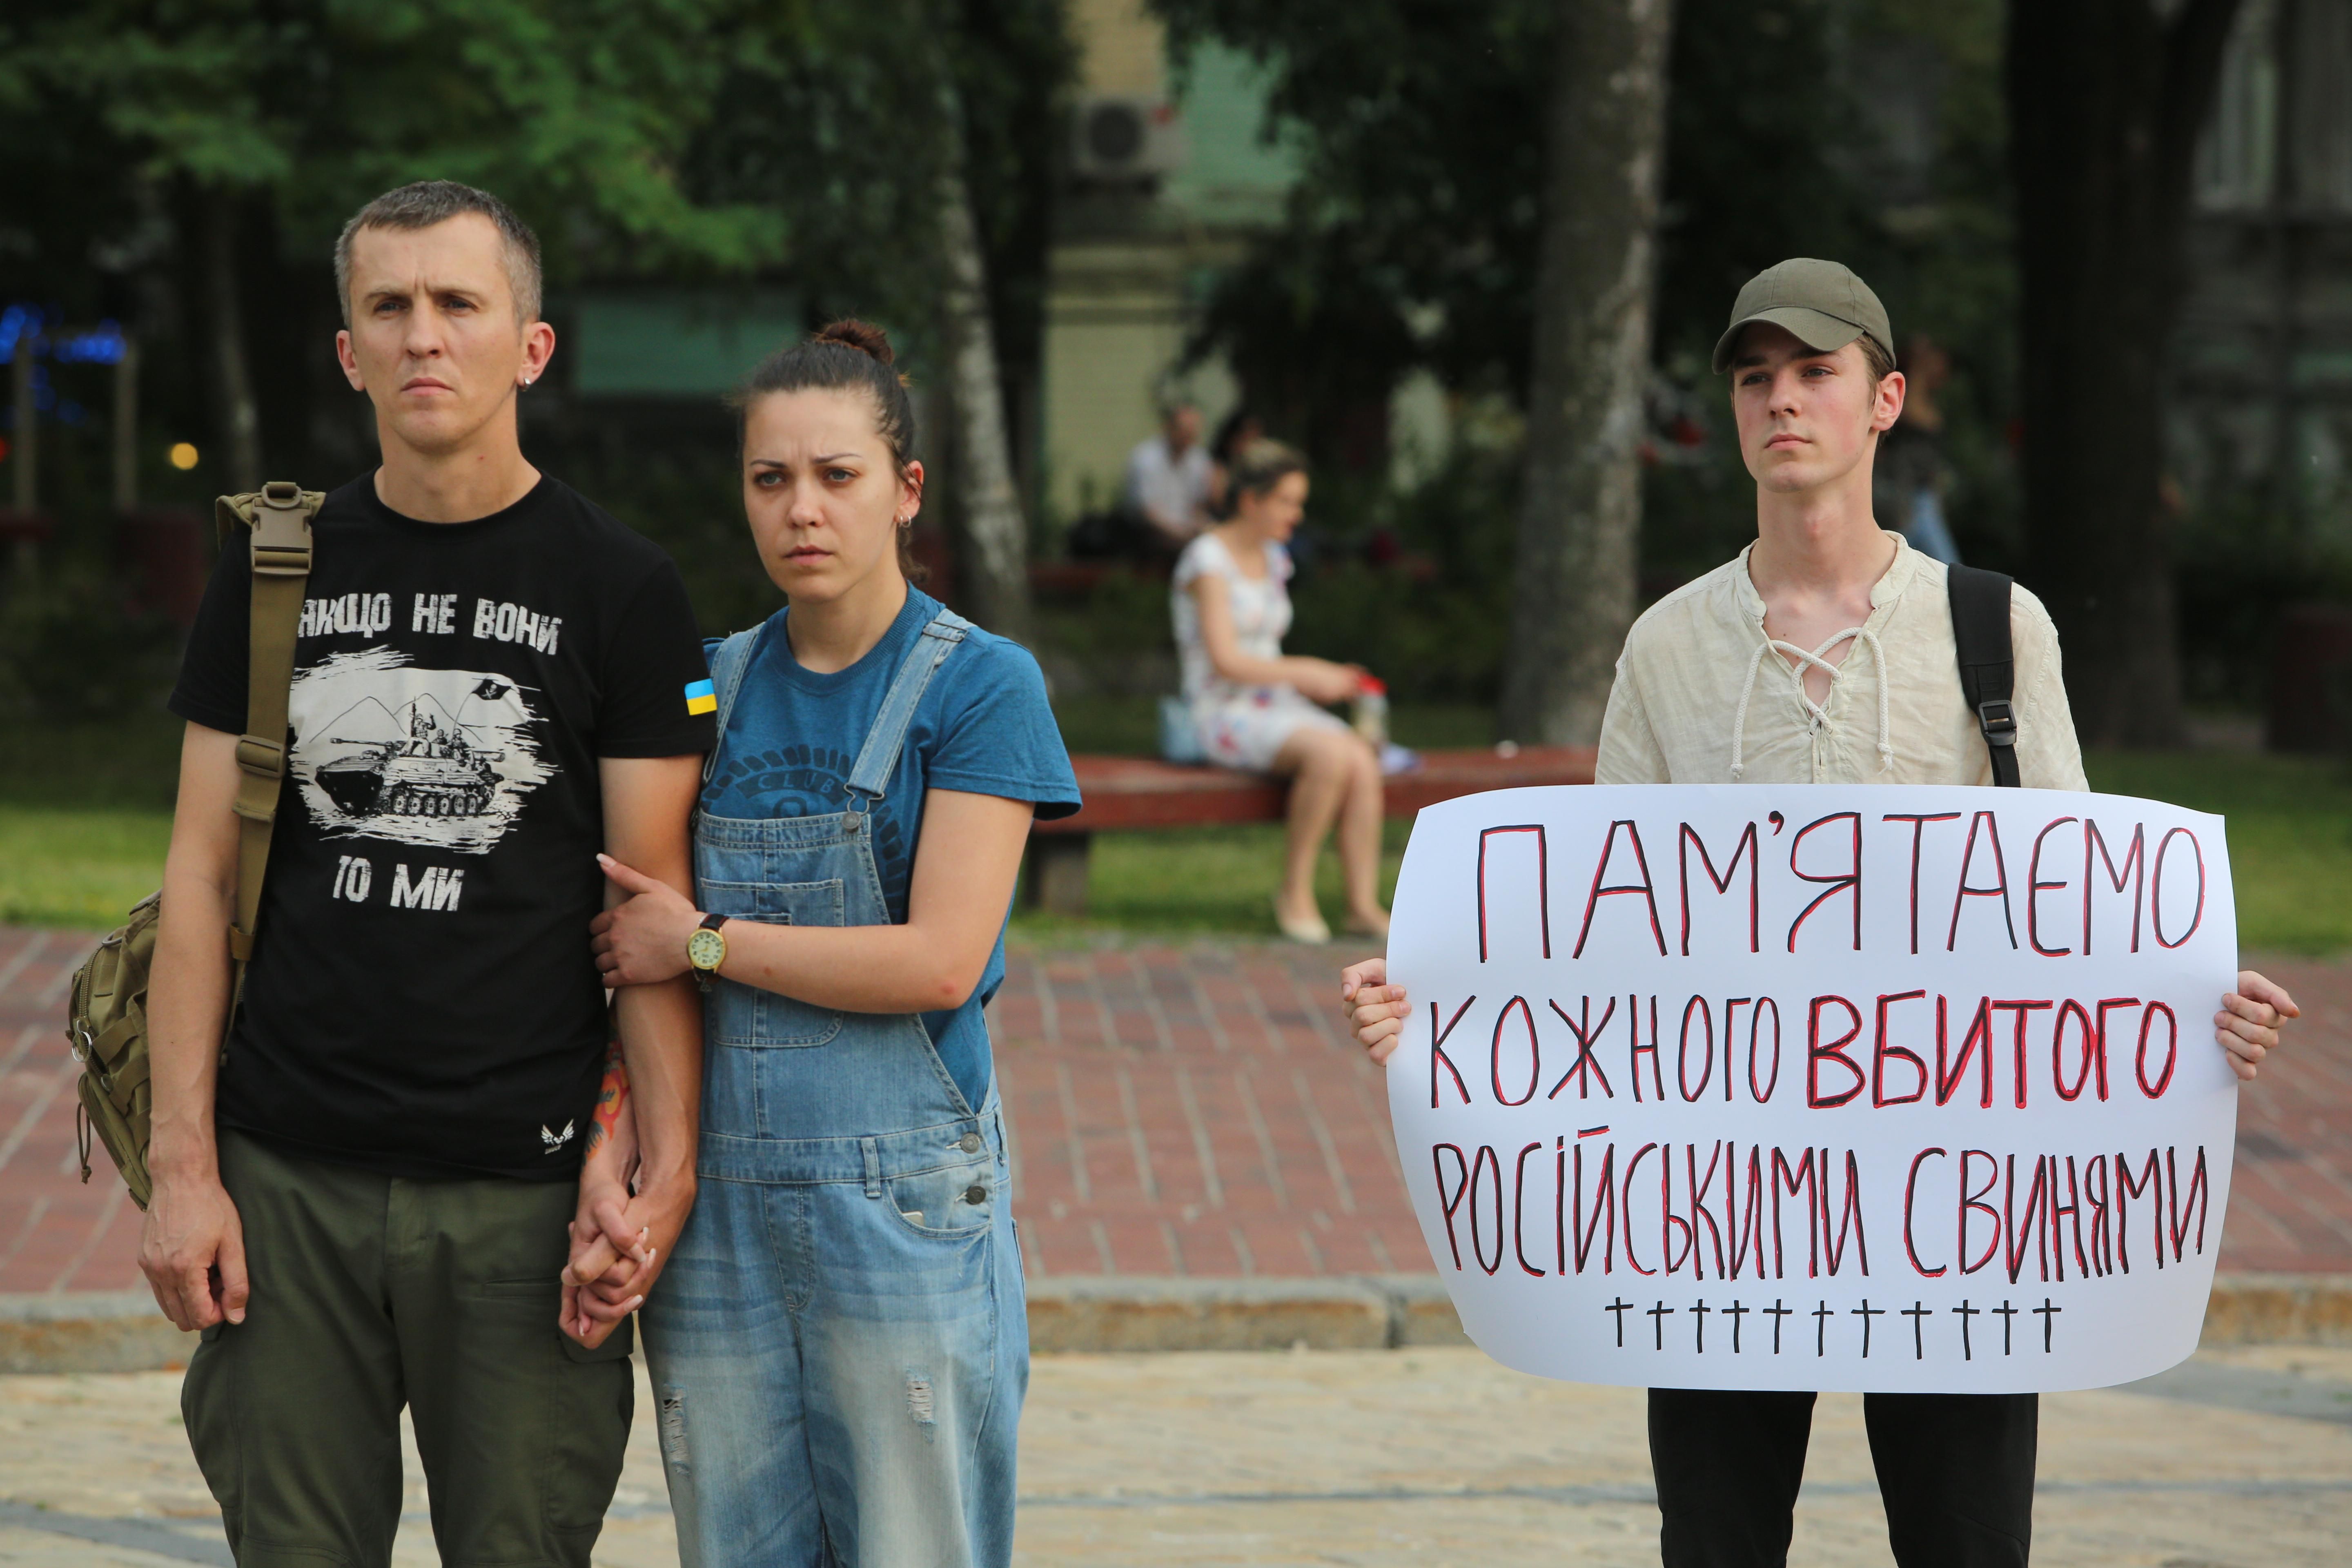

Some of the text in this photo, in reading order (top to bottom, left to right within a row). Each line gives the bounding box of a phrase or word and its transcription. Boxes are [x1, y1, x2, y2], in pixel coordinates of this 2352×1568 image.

[298, 592, 562, 655] ЯКЩО НЕ ВОНИ
[758, 772, 834, 793] CLUB
[332, 855, 464, 911] ТО МИ
[1477, 810, 2206, 963] ПАМ'ЯТАЄМО
[1430, 989, 2177, 1109] КОЖНОГО ВБИТОГО
[1432, 1125, 2208, 1285] РОСІЙСЬКИМИ СВИНЯМИ
